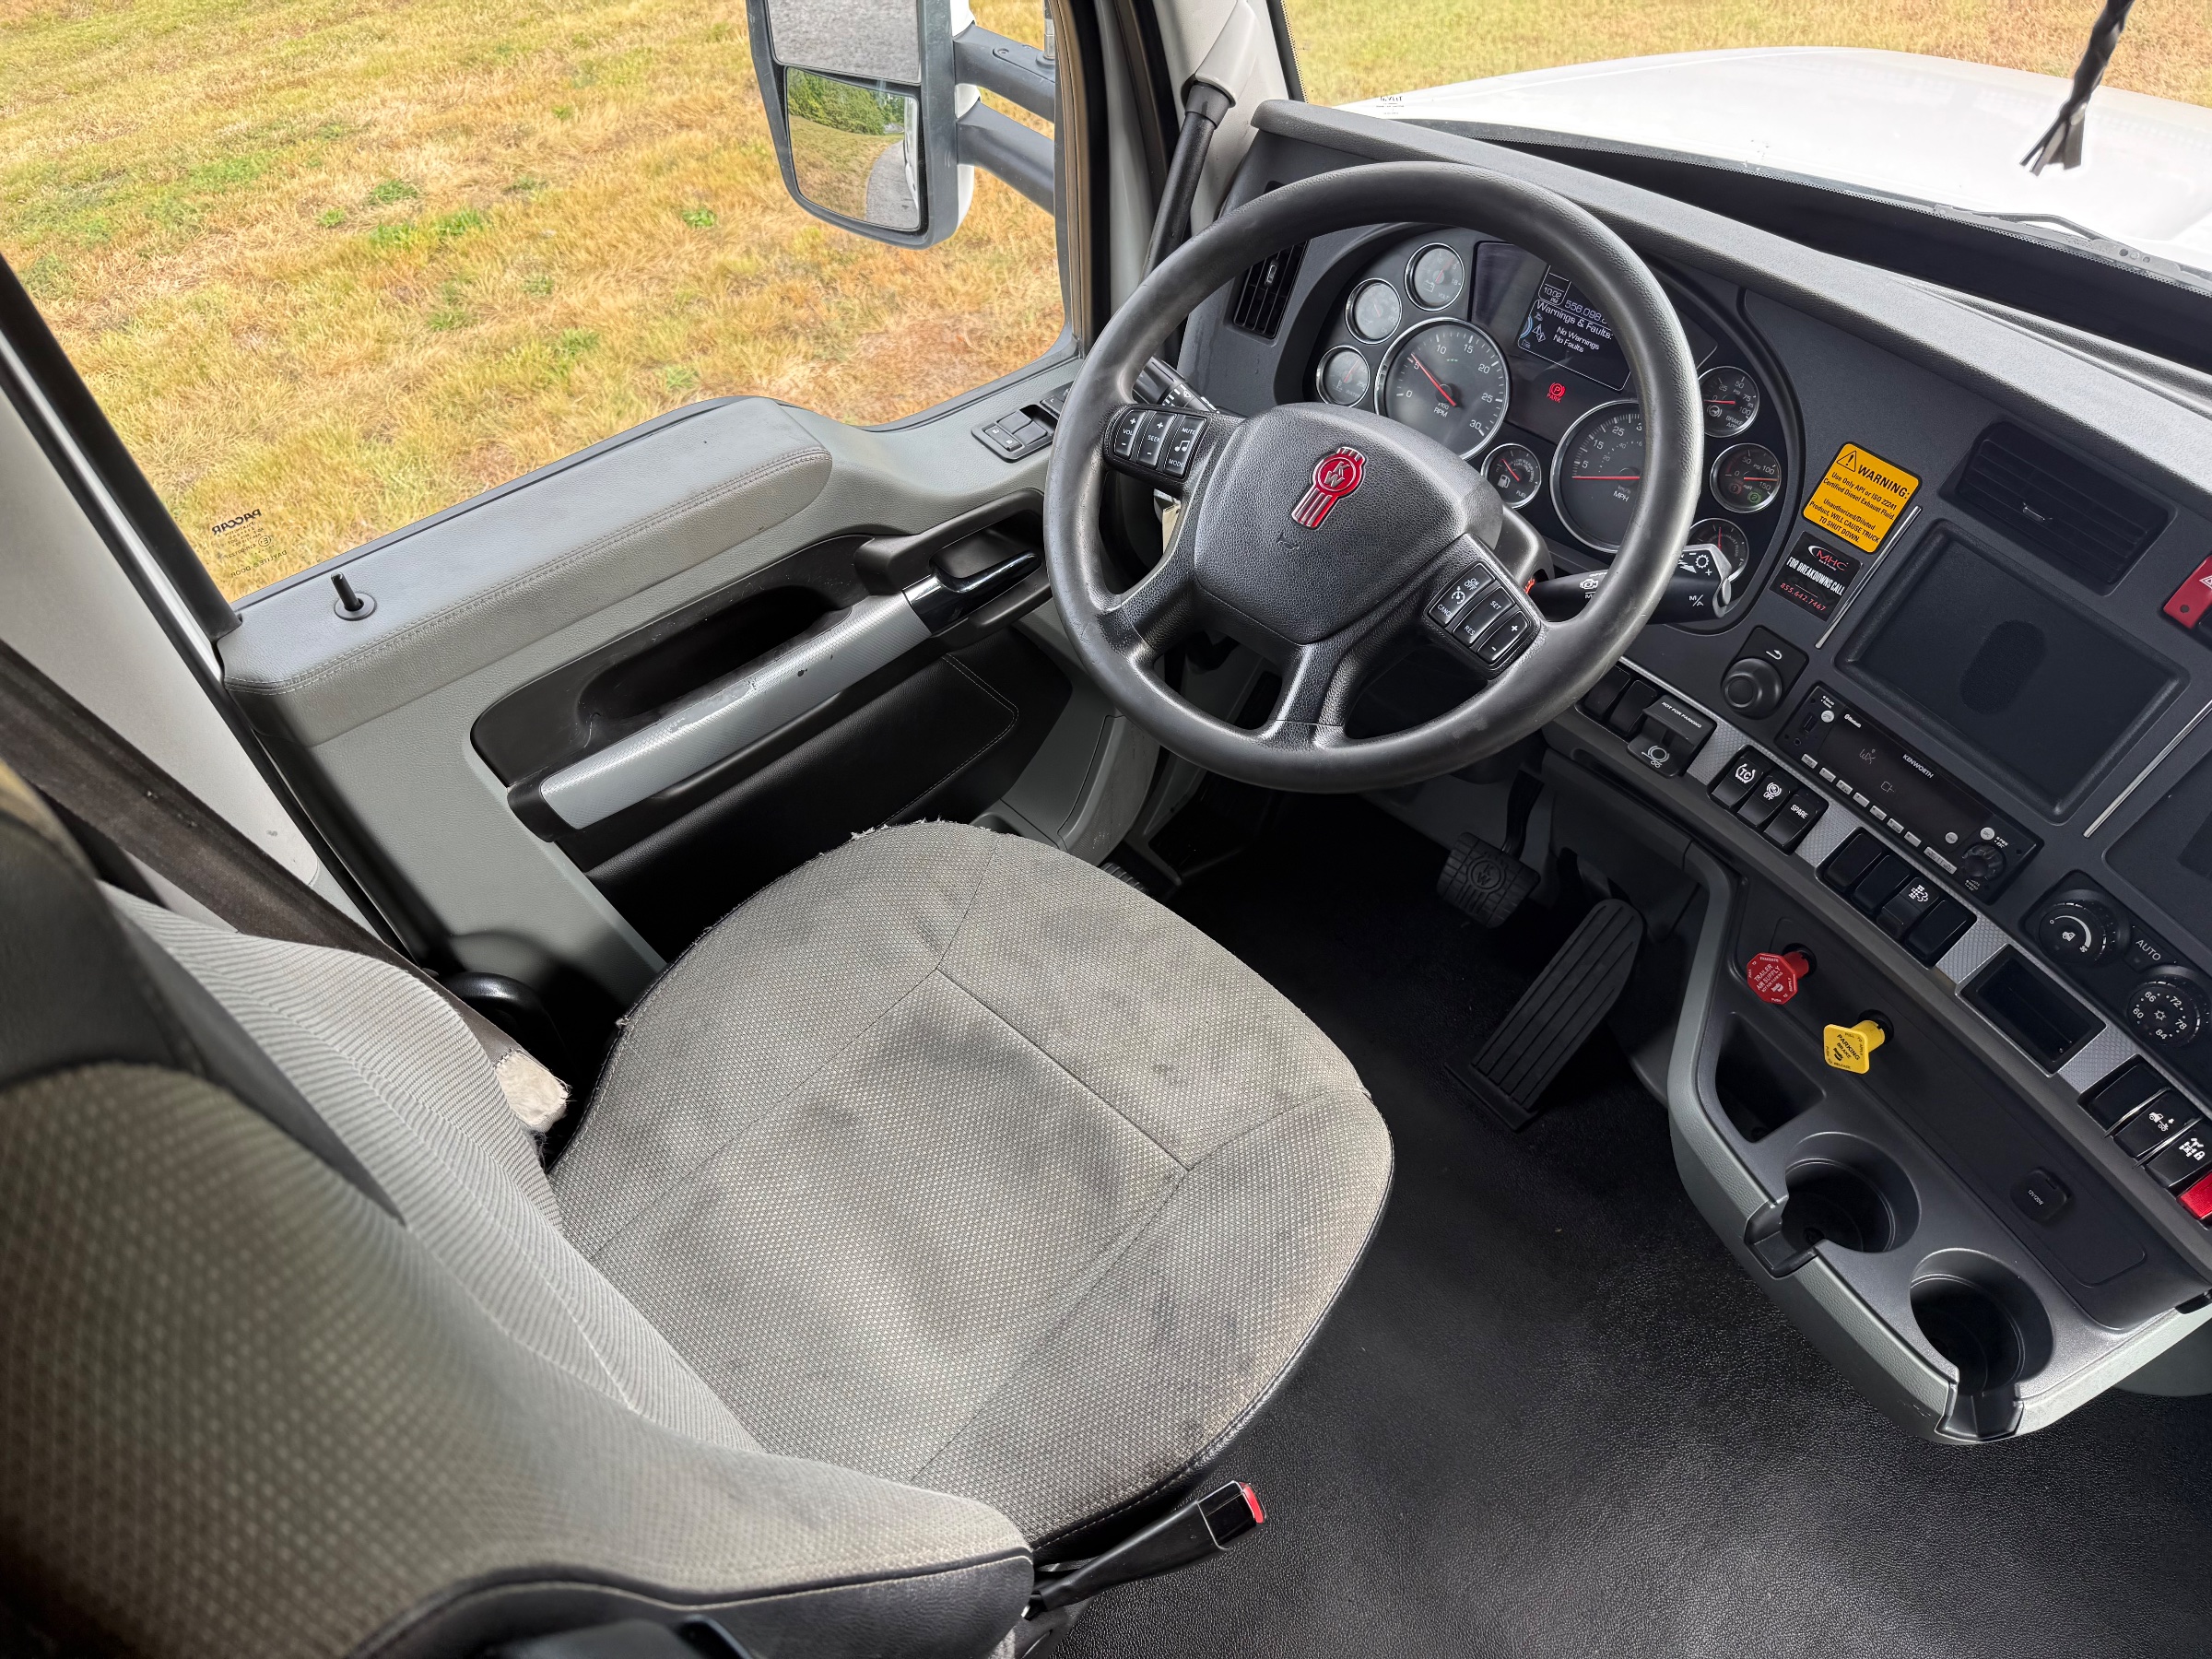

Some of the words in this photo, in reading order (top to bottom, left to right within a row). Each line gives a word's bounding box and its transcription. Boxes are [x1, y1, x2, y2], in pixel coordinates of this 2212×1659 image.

[1536, 300, 1576, 324] Warnings
[1577, 319, 1585, 328] &
[1586, 322, 1614, 340] Faults:
[1553, 334, 1564, 345] No
[1563, 338, 1584, 353] Faults
[1556, 326, 1568, 336] No
[1568, 331, 1600, 350] Warnings
[1436, 344, 1447, 355] 10
[1464, 344, 1474, 354] 15
[1477, 363, 1490, 374] 20
[1718, 383, 1728, 393] 25
[1735, 381, 1745, 389] 50
[1406, 390, 1413, 398] 0
[1481, 393, 1493, 404] 25
[1547, 393, 1561, 404] PARK
[1742, 394, 1752, 402] 75
[1433, 407, 1449, 418] RPM
[1739, 406, 1751, 416] 100
[1469, 419, 1482, 430] 30
[1725, 415, 1744, 426] BRAKE
[1181, 427, 1196, 436] MUTE
[1611, 425, 1625, 437] 25
[1147, 434, 1161, 443] SEEK
[1593, 439, 1604, 450] 15
[1168, 458, 1184, 468] MODE
[1582, 461, 1589, 469] 5
[1762, 465, 1775, 476] 100
[1759, 481, 1771, 491] 150
[1857, 465, 1910, 500] WARNING:
[1613, 490, 1630, 502] MPH
[1831, 471, 1842, 481] Use
[1841, 477, 1854, 489] Only
[1854, 484, 1865, 494] API
[1871, 493, 1882, 502] ISO
[1881, 499, 1897, 512] 22241
[1823, 477, 1844, 493] Certified
[1843, 488, 1861, 502] Diesel
[1860, 499, 1882, 513] Exhaust
[1880, 509, 1895, 521] Fluid.
[1823, 498, 1877, 531] Unauthorized/Diluted
[1818, 515, 1827, 524] TO
[1826, 520, 1841, 532] SHUT
[1841, 528, 1860, 543] DOWN.
[1830, 512, 1843, 524] WILL
[1843, 519, 1863, 534] CAUSE
[1862, 529, 1881, 544] TRUCK
[1816, 549, 1848, 571] MHC
[1471, 577, 1480, 586] ON
[1786, 556, 1800, 570] FOR
[1796, 562, 1834, 589] BREAKDOWNS
[1830, 581, 1846, 596] CALL
[1464, 581, 1477, 591] OFF
[1780, 582, 1827, 611] 855.642.7467
[1489, 600, 1502, 610] SET
[1464, 625, 1475, 636] RES
[1662, 701, 1673, 710] NOT
[1671, 708, 1682, 716] FOR
[1681, 713, 1702, 728] PARKING
[1902, 753, 1935, 779] KENWORTH
[1739, 768, 1752, 780] TC
[1762, 791, 1775, 801] OFF
[1790, 804, 1808, 819] SPARE
[2135, 939, 2161, 961] AUTO
[1754, 963, 1773, 982] TRAILER
[1756, 981, 1765, 990] AIR
[1762, 965, 1781, 983] SUPPLY
[2144, 991, 2157, 1003] 66
[2170, 995, 2183, 1008] 72
[2132, 1007, 2145, 1019] 60
[2175, 1018, 2187, 1030] 78
[2155, 1029, 2168, 1041] 84
[1836, 1042, 1852, 1059] BRAKE
[1837, 1033, 1861, 1061] PARKING
